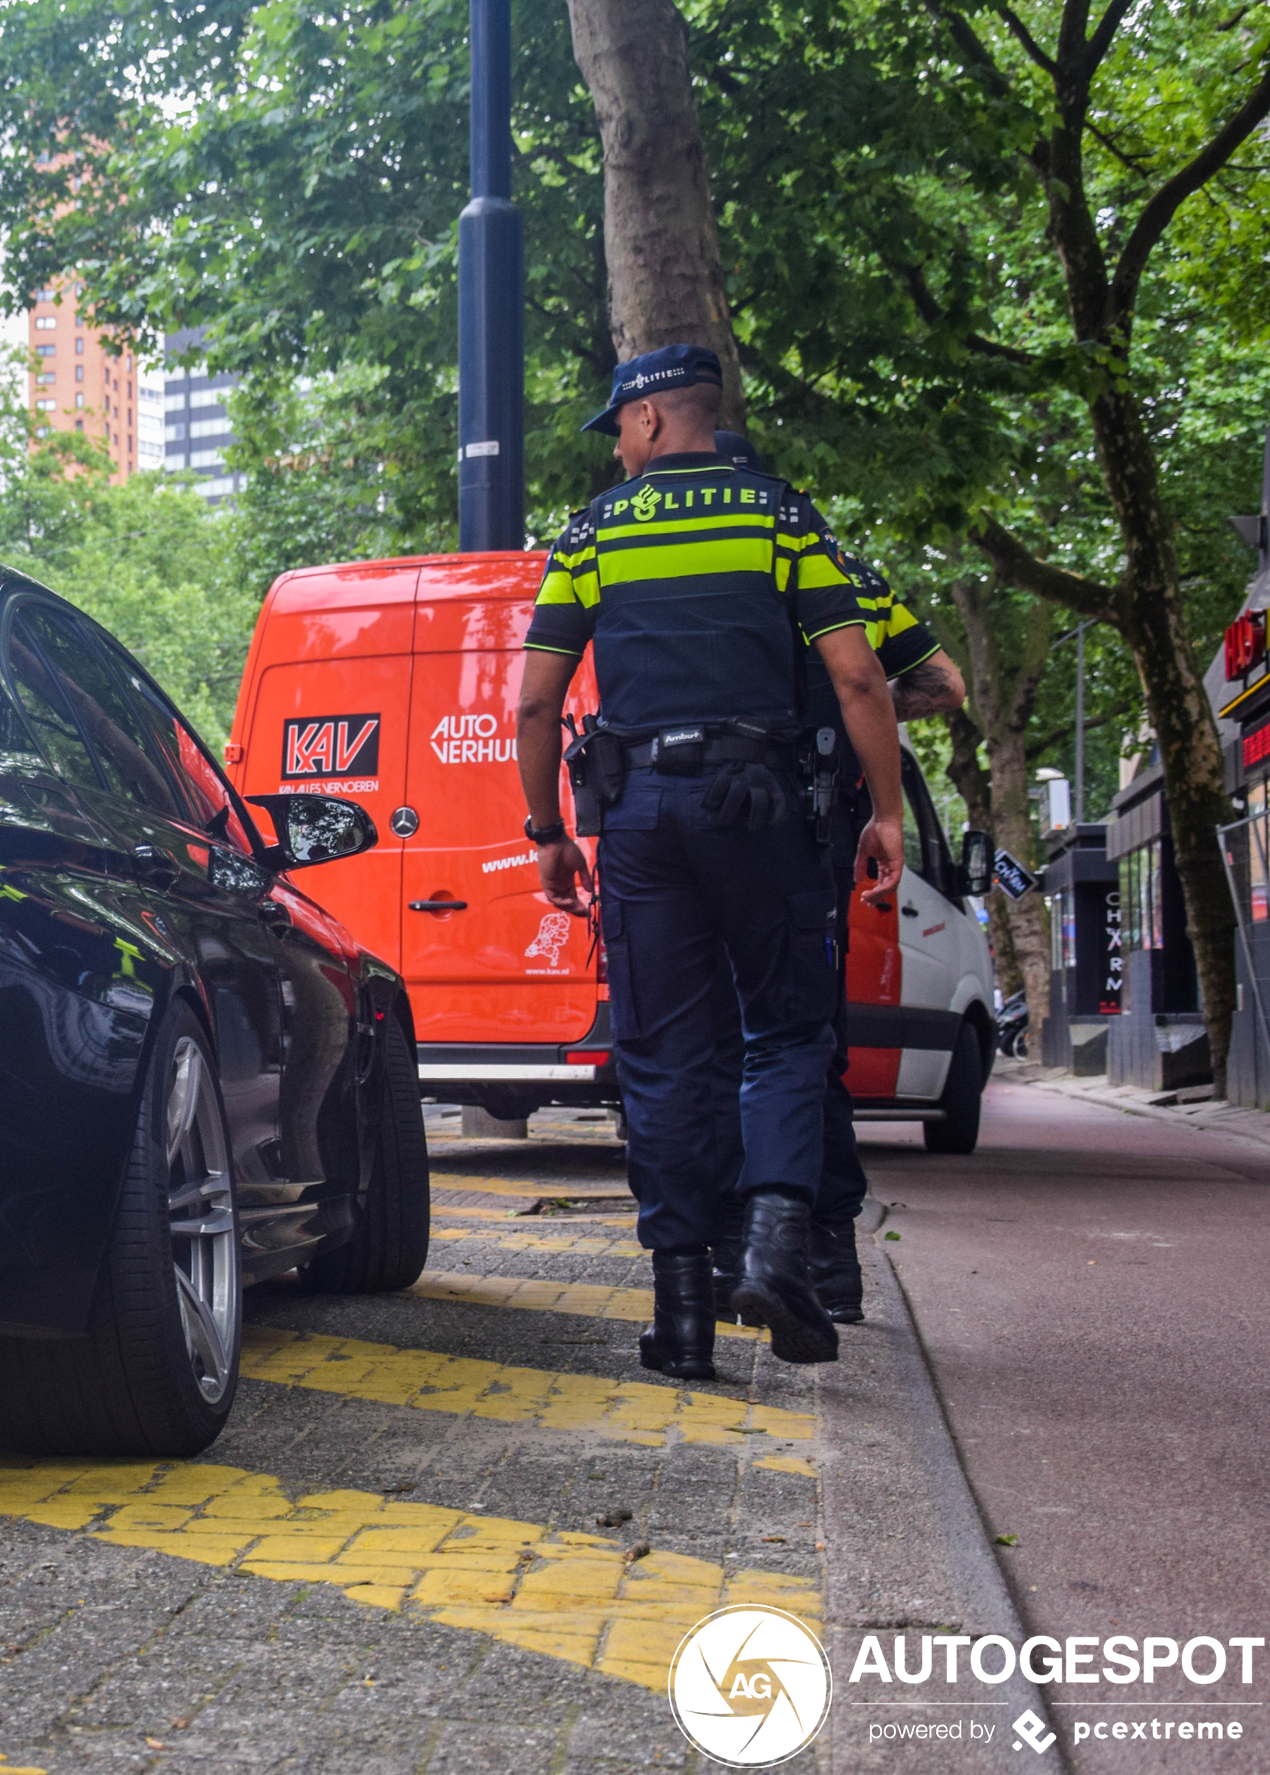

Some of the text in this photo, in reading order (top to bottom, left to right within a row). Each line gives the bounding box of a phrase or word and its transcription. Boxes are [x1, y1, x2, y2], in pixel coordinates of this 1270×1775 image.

[430, 714, 497, 740] AUTO
[286, 720, 378, 774] KAV
[321, 780, 379, 794] VERVOEREN
